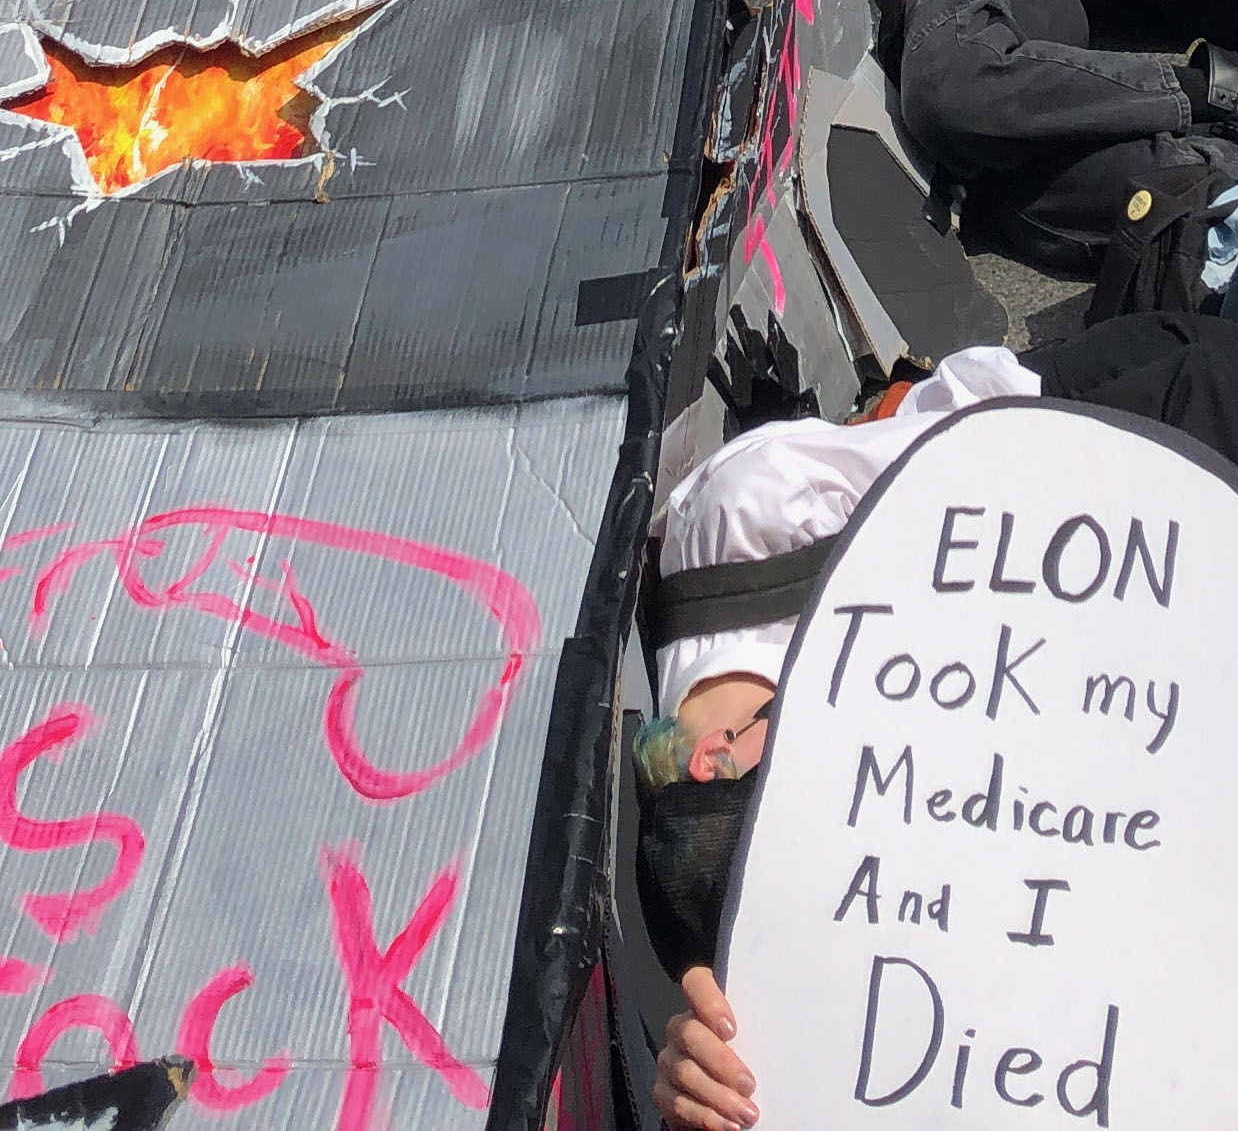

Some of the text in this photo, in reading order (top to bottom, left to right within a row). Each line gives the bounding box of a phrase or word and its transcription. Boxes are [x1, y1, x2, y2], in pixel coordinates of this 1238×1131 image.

[932, 505, 1180, 608] ELON
[1081, 673, 1180, 755] my
[847, 744, 1161, 851] Medicare
[833, 854, 1071, 946] And I
[854, 955, 1120, 1128] Died
